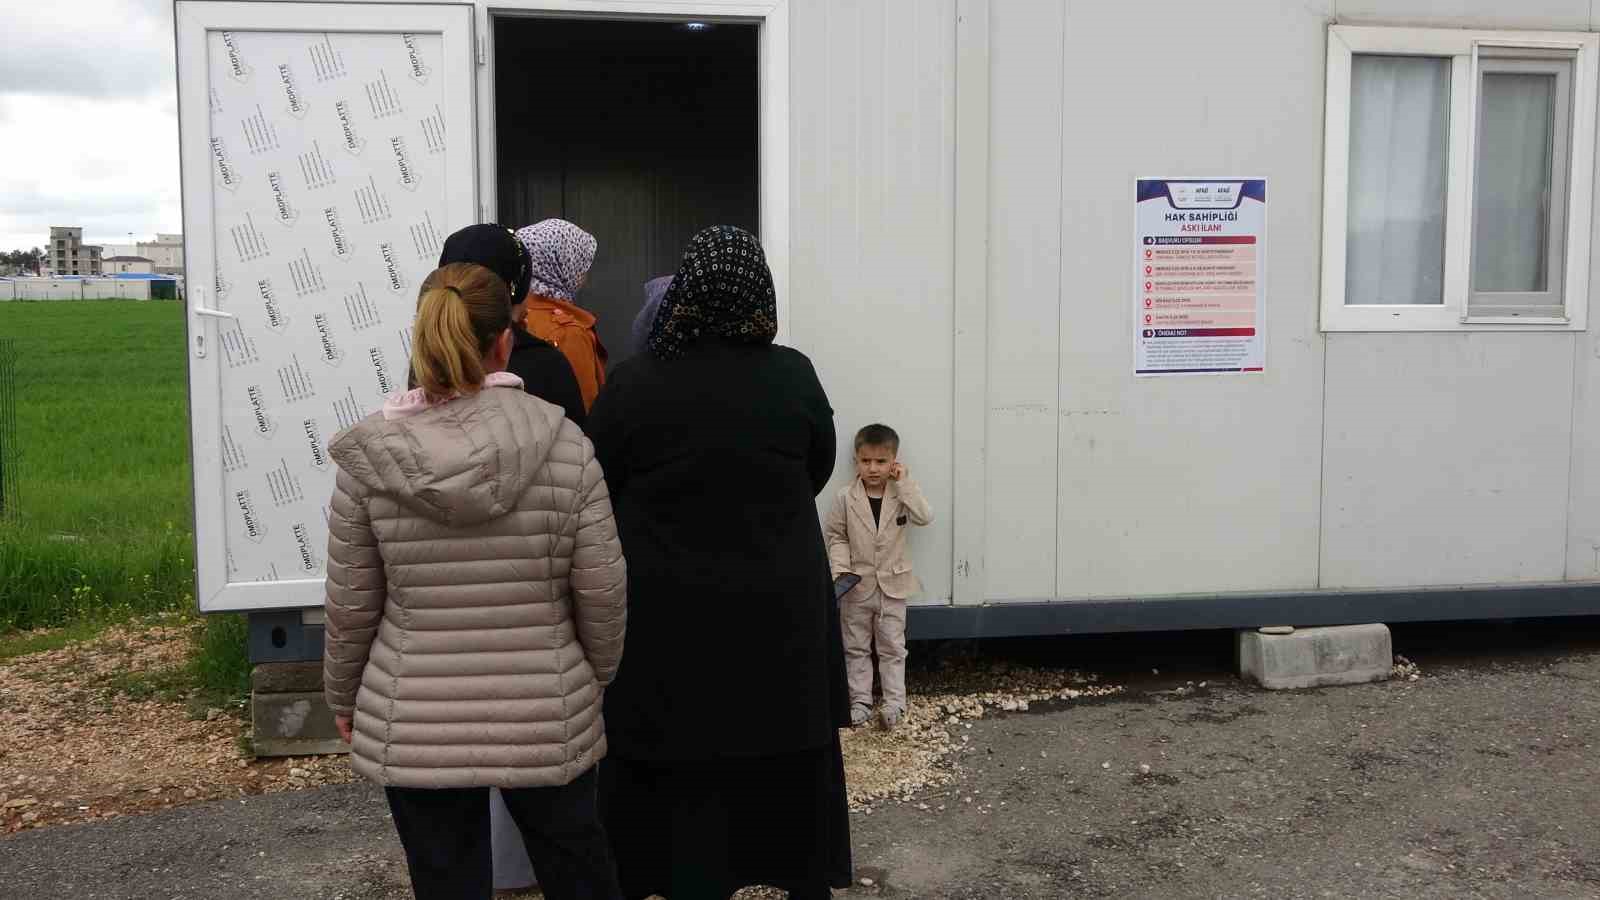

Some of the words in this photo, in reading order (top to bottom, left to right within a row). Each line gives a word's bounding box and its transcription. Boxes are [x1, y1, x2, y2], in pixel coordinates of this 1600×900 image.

[223, 32, 242, 76] DMOPLATT
[403, 34, 422, 77] DMOPLATT
[1164, 213, 1186, 221] HAK
[1188, 211, 1238, 221] SAHİPLİĞİ
[1181, 224, 1199, 232] ASKI
[1201, 223, 1222, 232] İLANI
